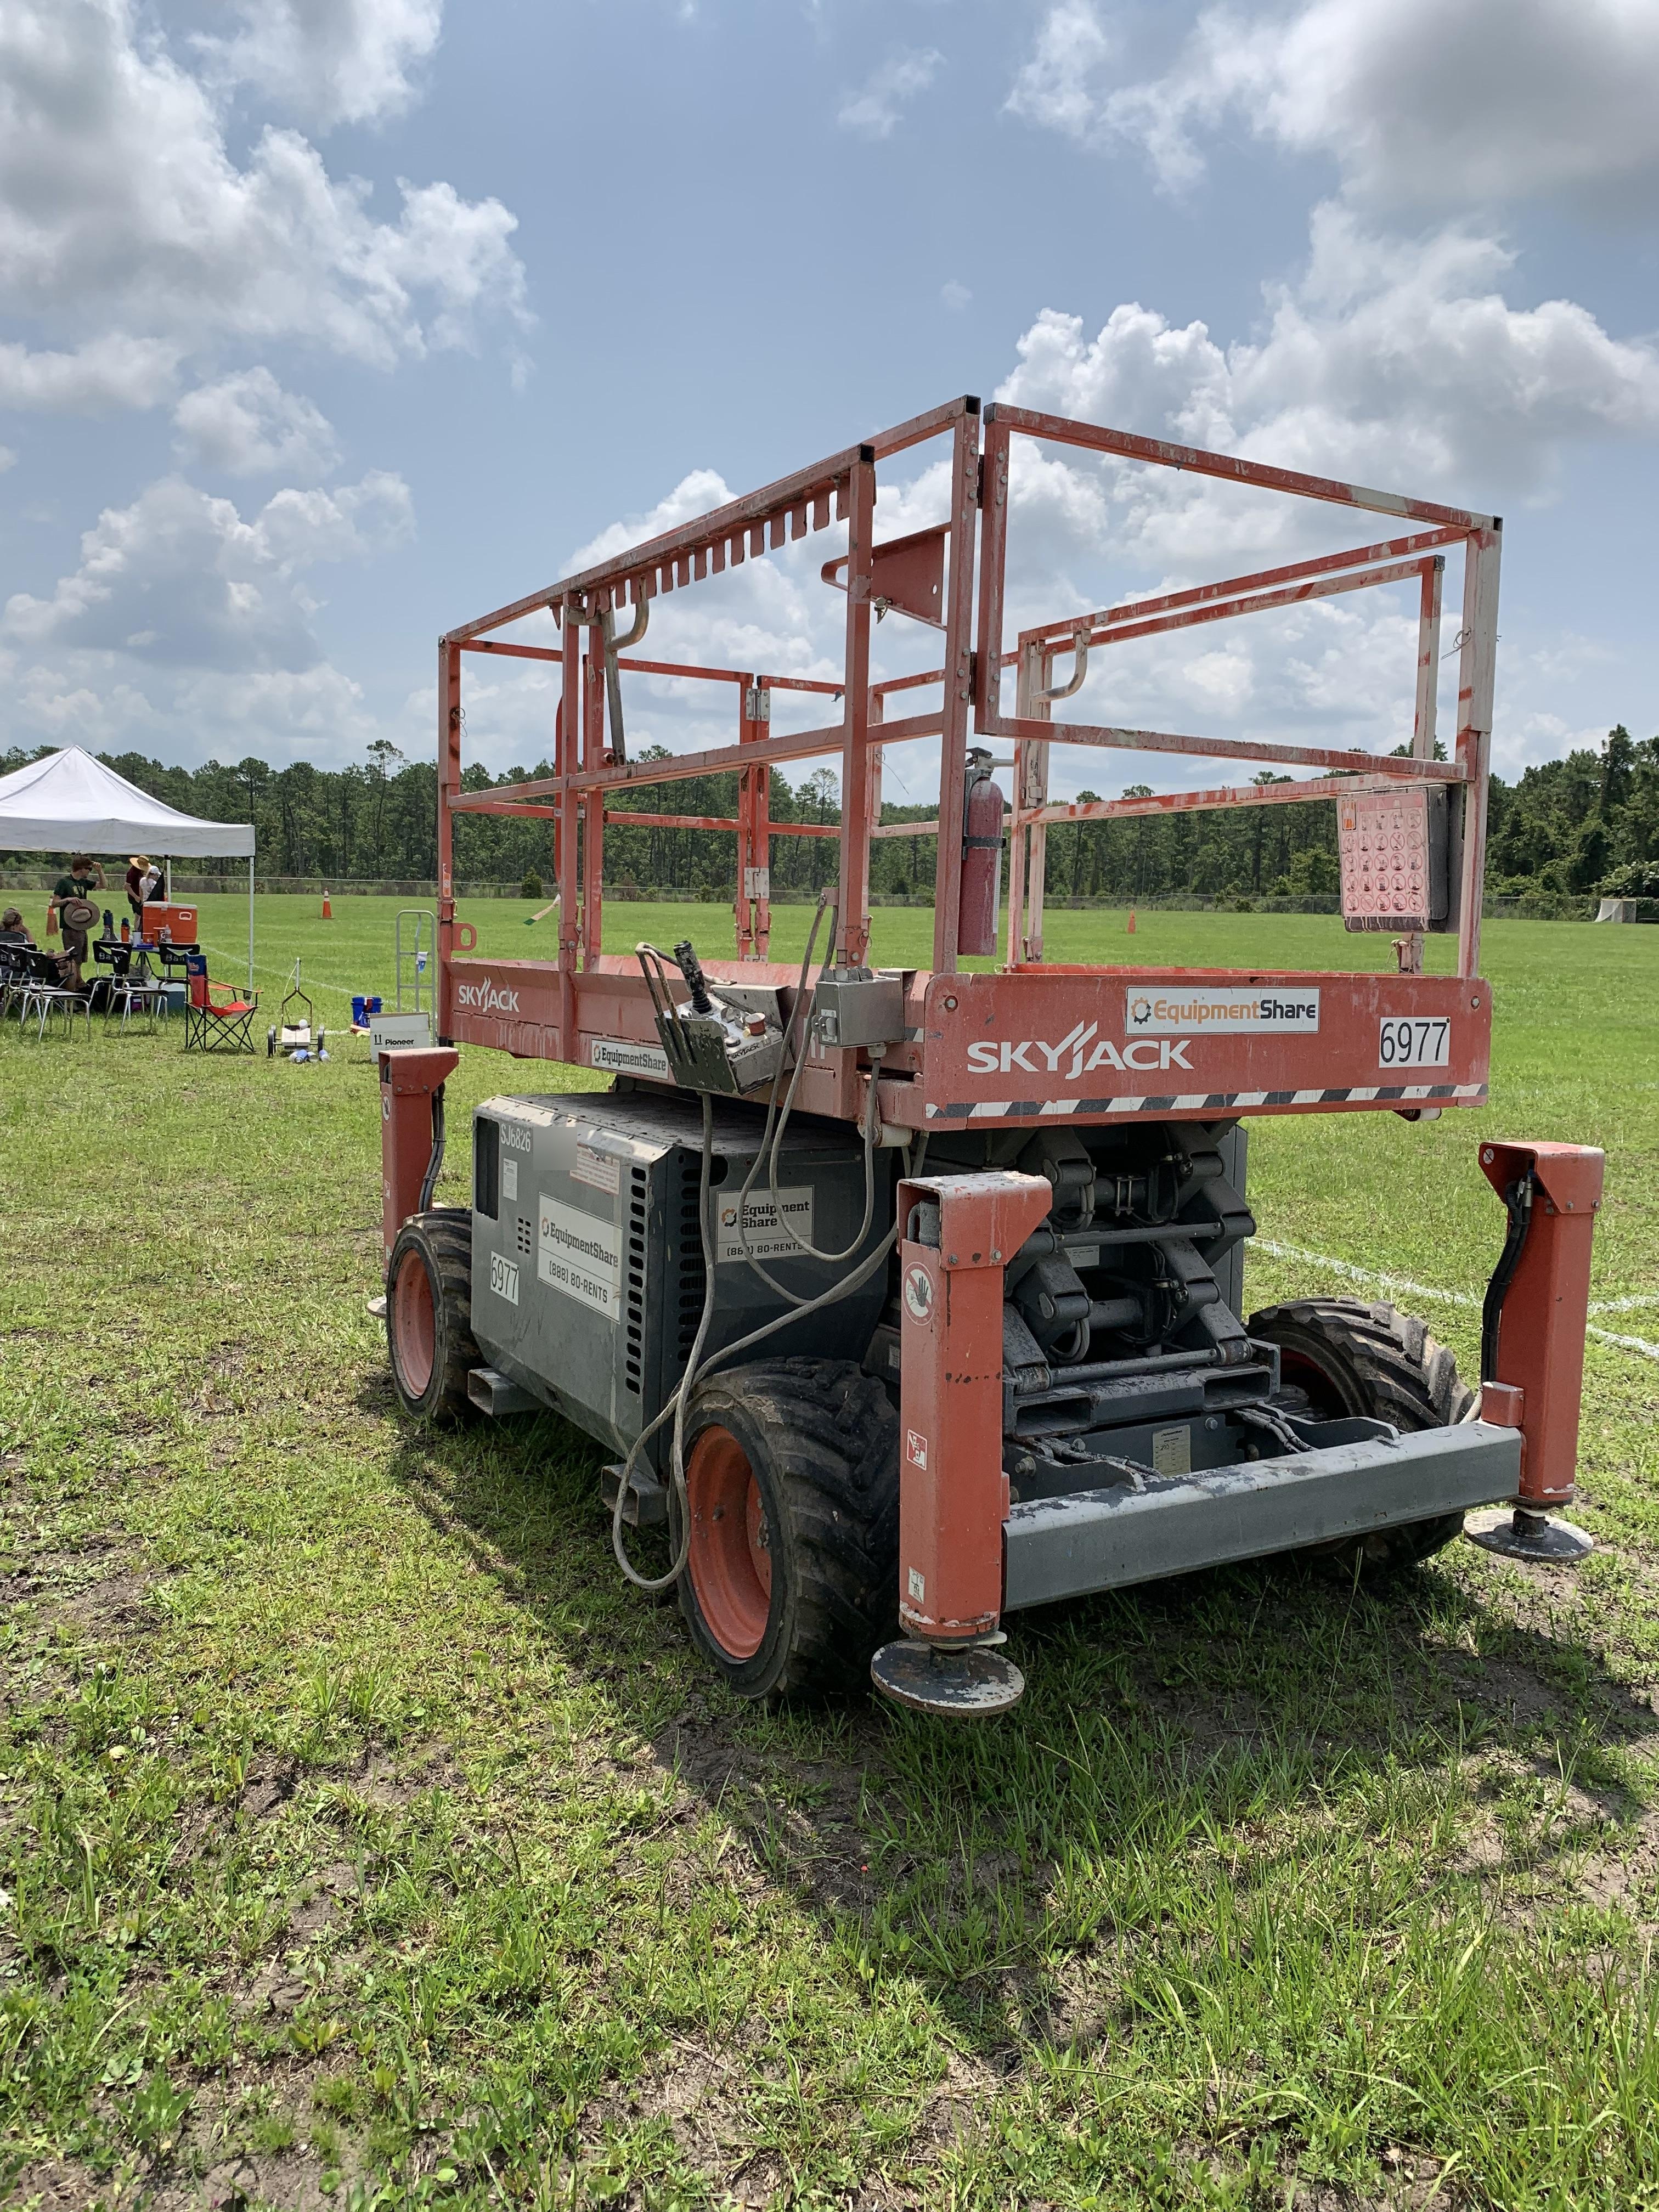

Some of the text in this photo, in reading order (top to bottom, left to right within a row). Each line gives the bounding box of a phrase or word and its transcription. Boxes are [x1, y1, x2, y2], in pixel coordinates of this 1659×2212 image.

[459, 976, 520, 1013] SKYJACK
[1154, 999, 1316, 1025] EquipmentShare
[602, 1047, 666, 1071] EquipmentShare
[967, 1020, 1195, 1080] SKYJACK
[1380, 1022, 1447, 1063] 6977
[500, 1124, 531, 1153] SJ6826
[742, 1217, 778, 1228] Share
[550, 1222, 618, 1268] EquipmentShare
[492, 1257, 517, 1299] 6977
[549, 1260, 608, 1303] (888) 80-RENTS
